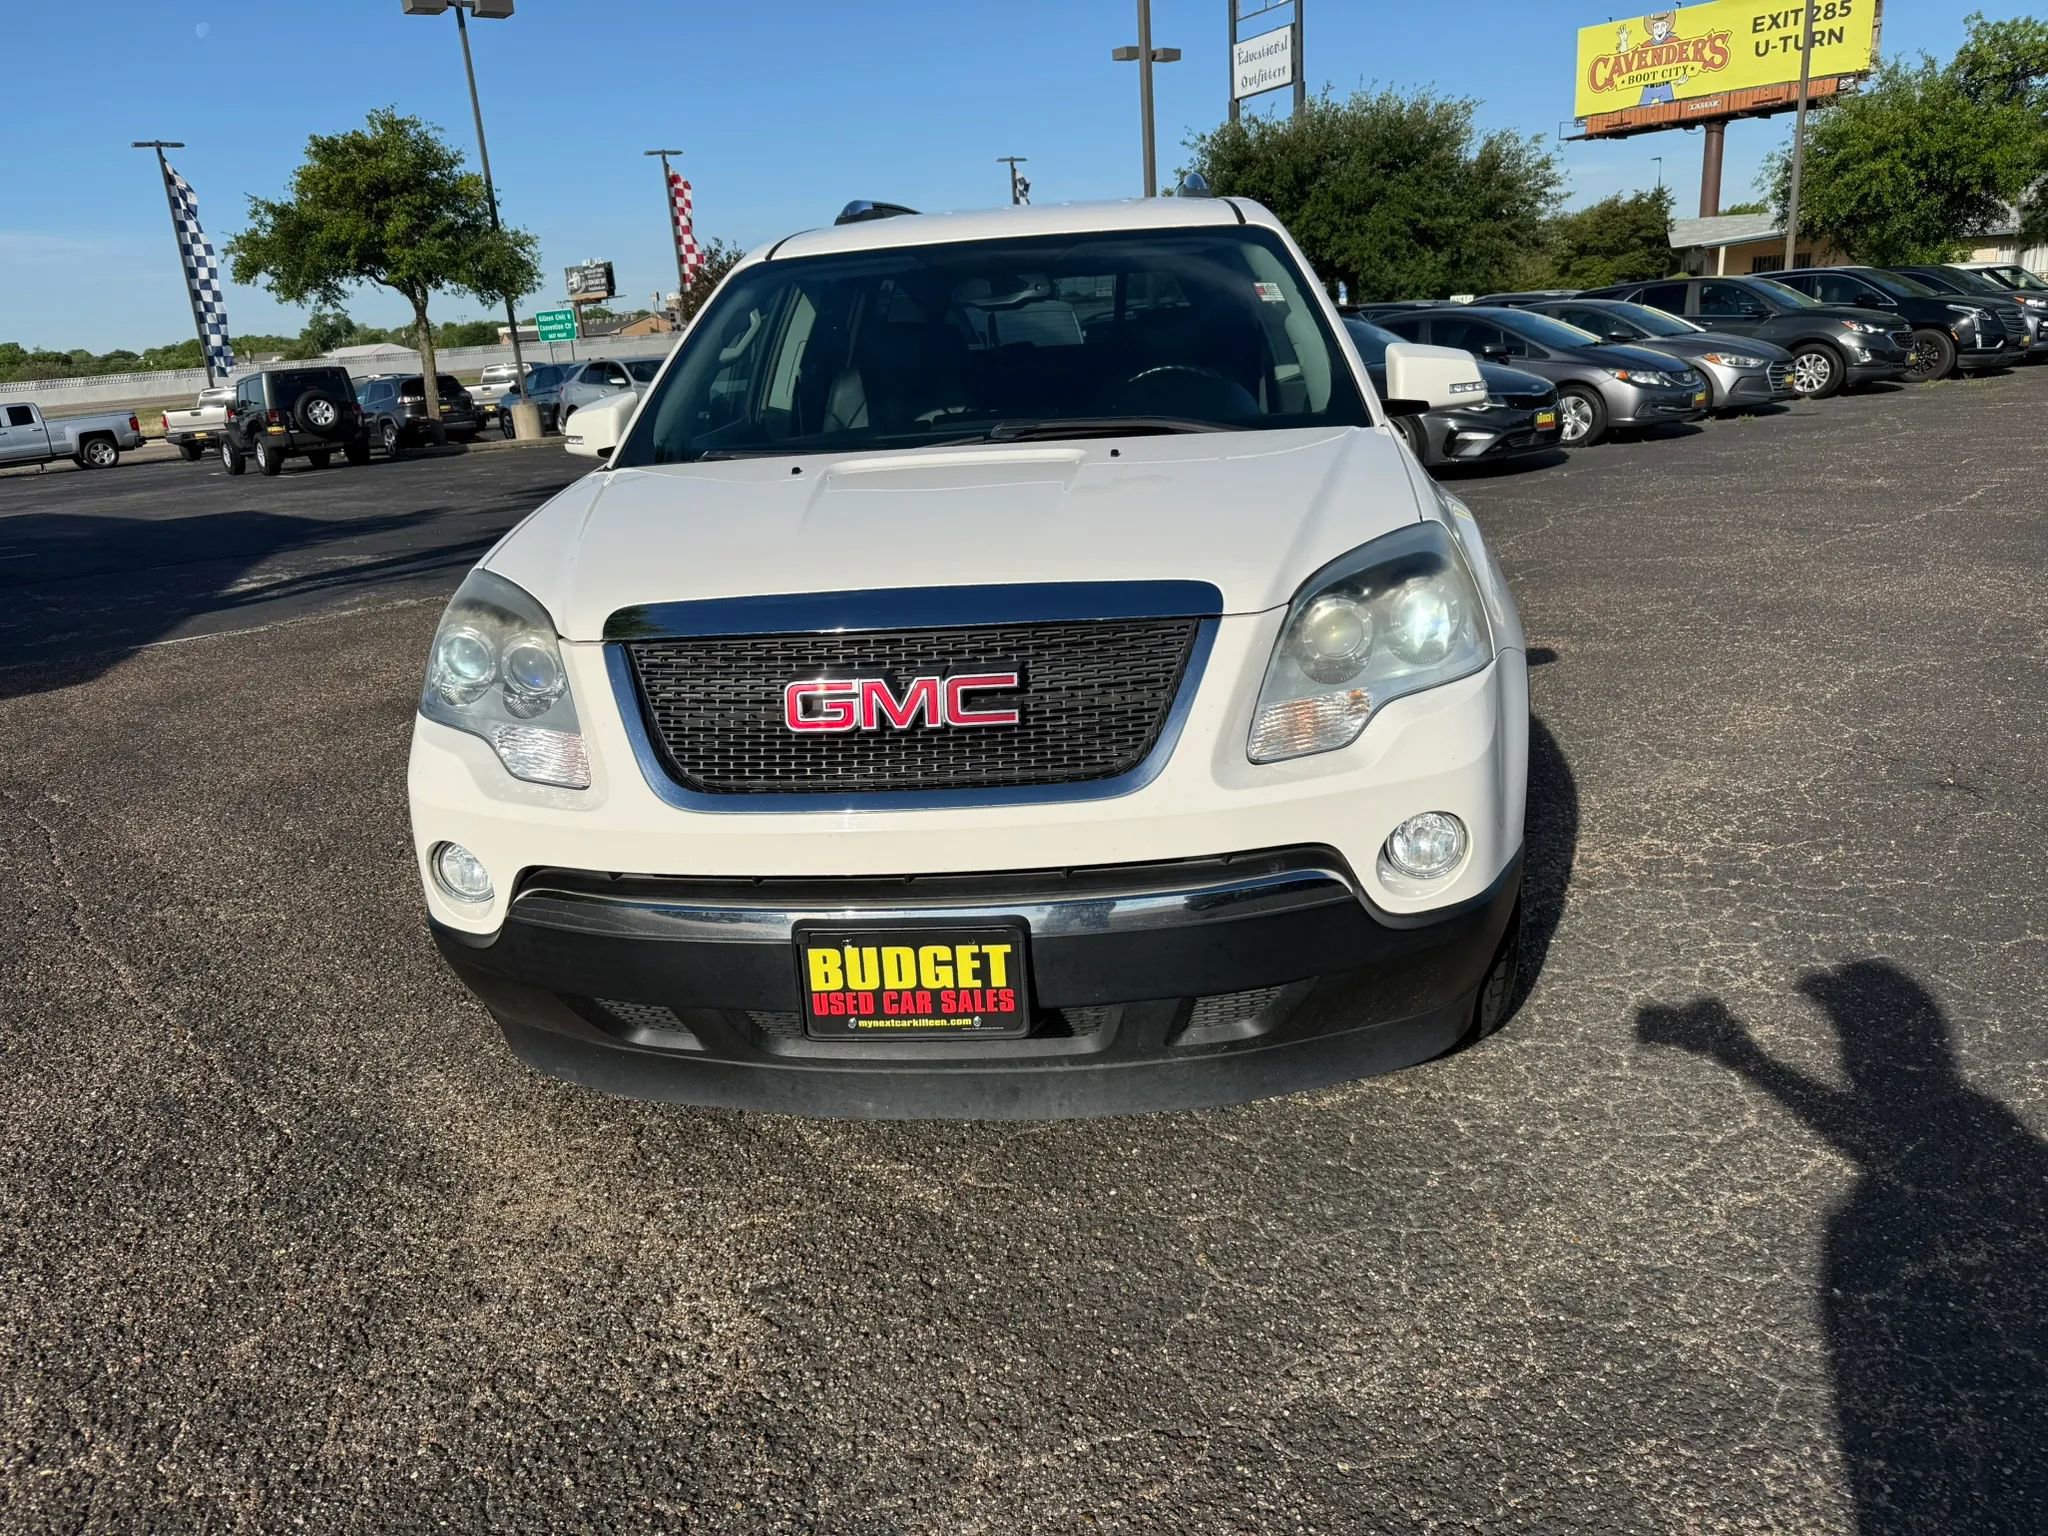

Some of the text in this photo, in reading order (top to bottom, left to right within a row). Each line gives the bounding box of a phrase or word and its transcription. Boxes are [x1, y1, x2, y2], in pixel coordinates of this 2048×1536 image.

[1752, 0, 1852, 34] EXIT 285
[1238, 35, 1288, 66] Educational
[1755, 26, 1844, 57] U-TURN
[1241, 65, 1286, 88] Outfitters
[1588, 32, 1730, 92] CAVENDER'S
[1628, 65, 1689, 85] BOOT CITY
[538, 314, 555, 322] Killeen
[555, 313, 567, 321] Civic
[785, 672, 1019, 732] GMC
[808, 944, 1012, 991] BUDGET
[812, 989, 1015, 1016] USED CAR SALES
[858, 1017, 972, 1029] mynextcarkilleen.com
